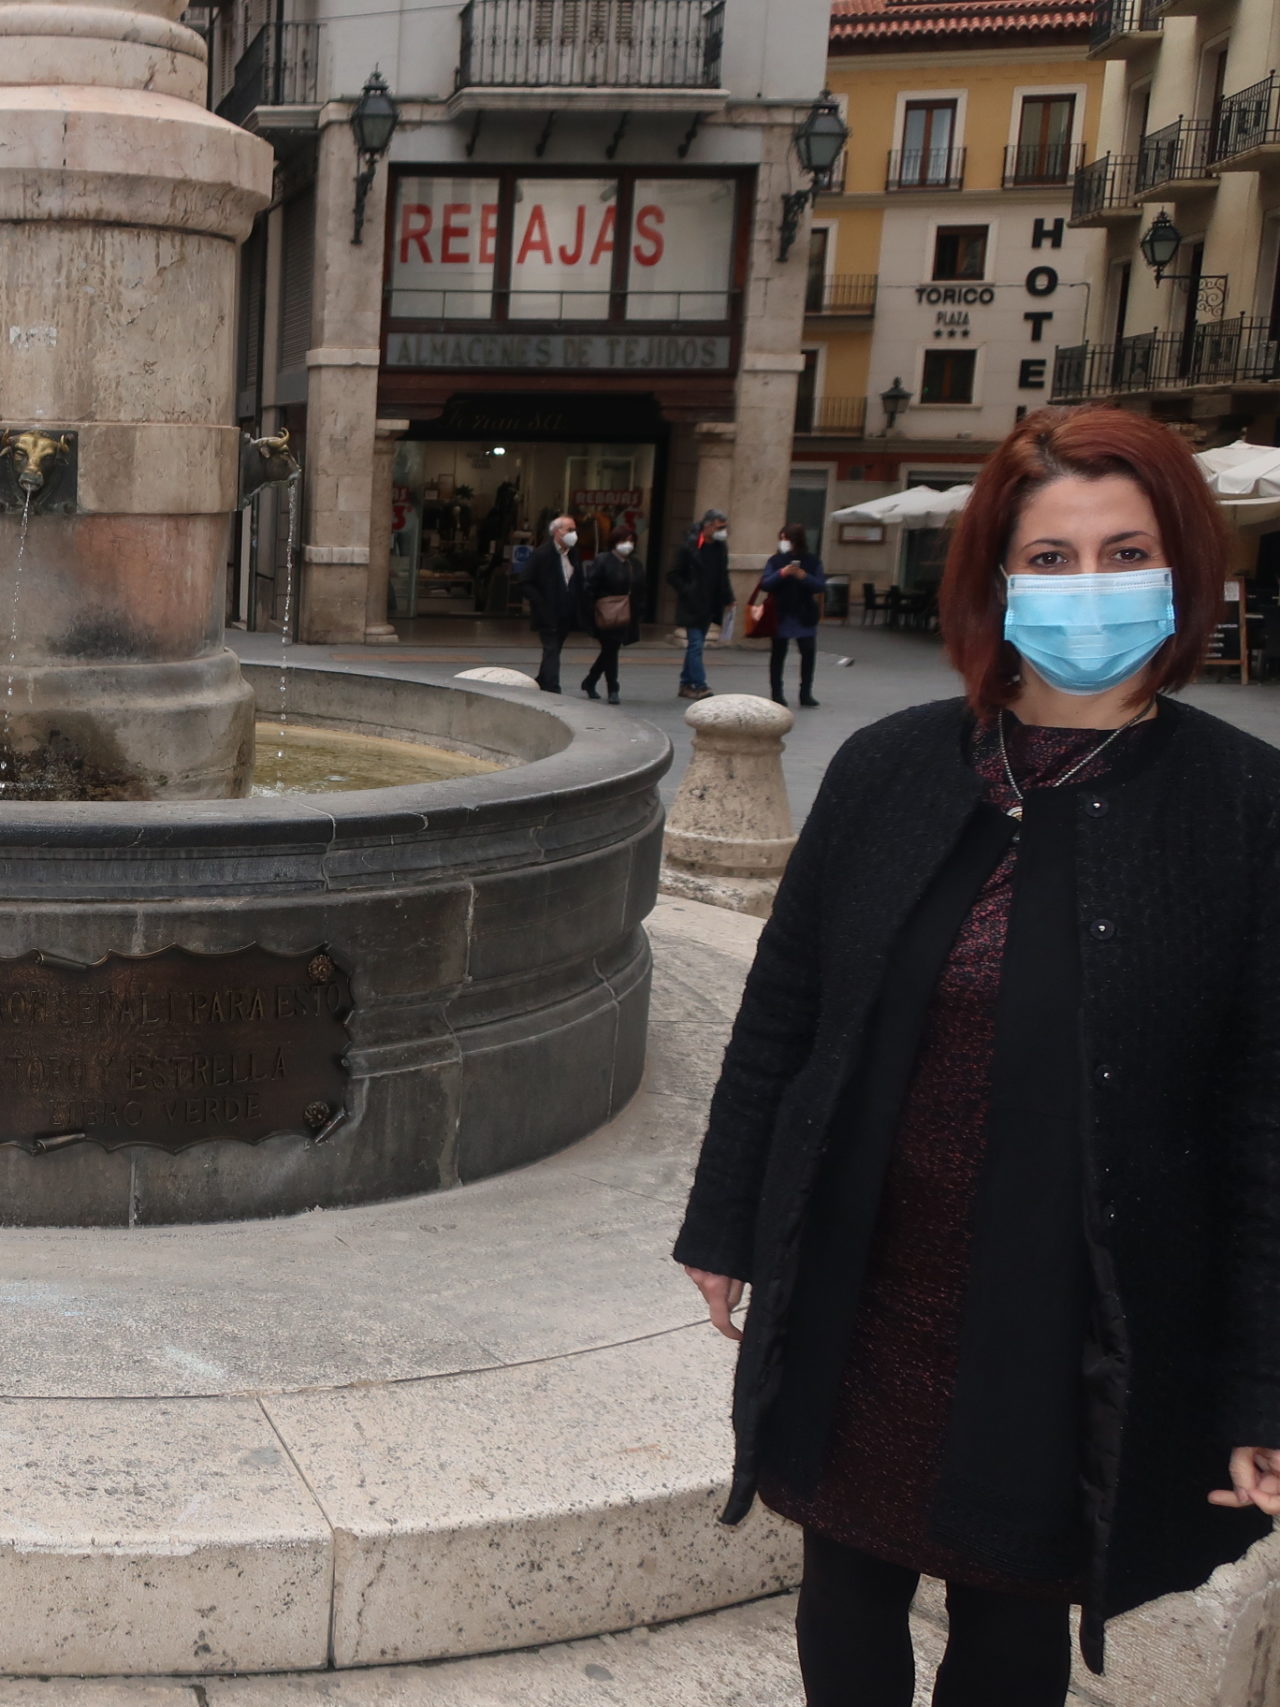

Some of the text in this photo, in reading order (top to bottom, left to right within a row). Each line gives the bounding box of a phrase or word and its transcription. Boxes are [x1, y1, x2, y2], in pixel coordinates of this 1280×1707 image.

[915, 287, 995, 305] TORICO
[936, 311, 970, 326] PLAZA
[396, 336, 718, 368] ALMACENES DE TEJIDOS
[190, 986, 266, 1025] PARA
[276, 981, 342, 1020] ESTO
[128, 1046, 289, 1091] ESTRELLA
[162, 1093, 263, 1126] VERDE
